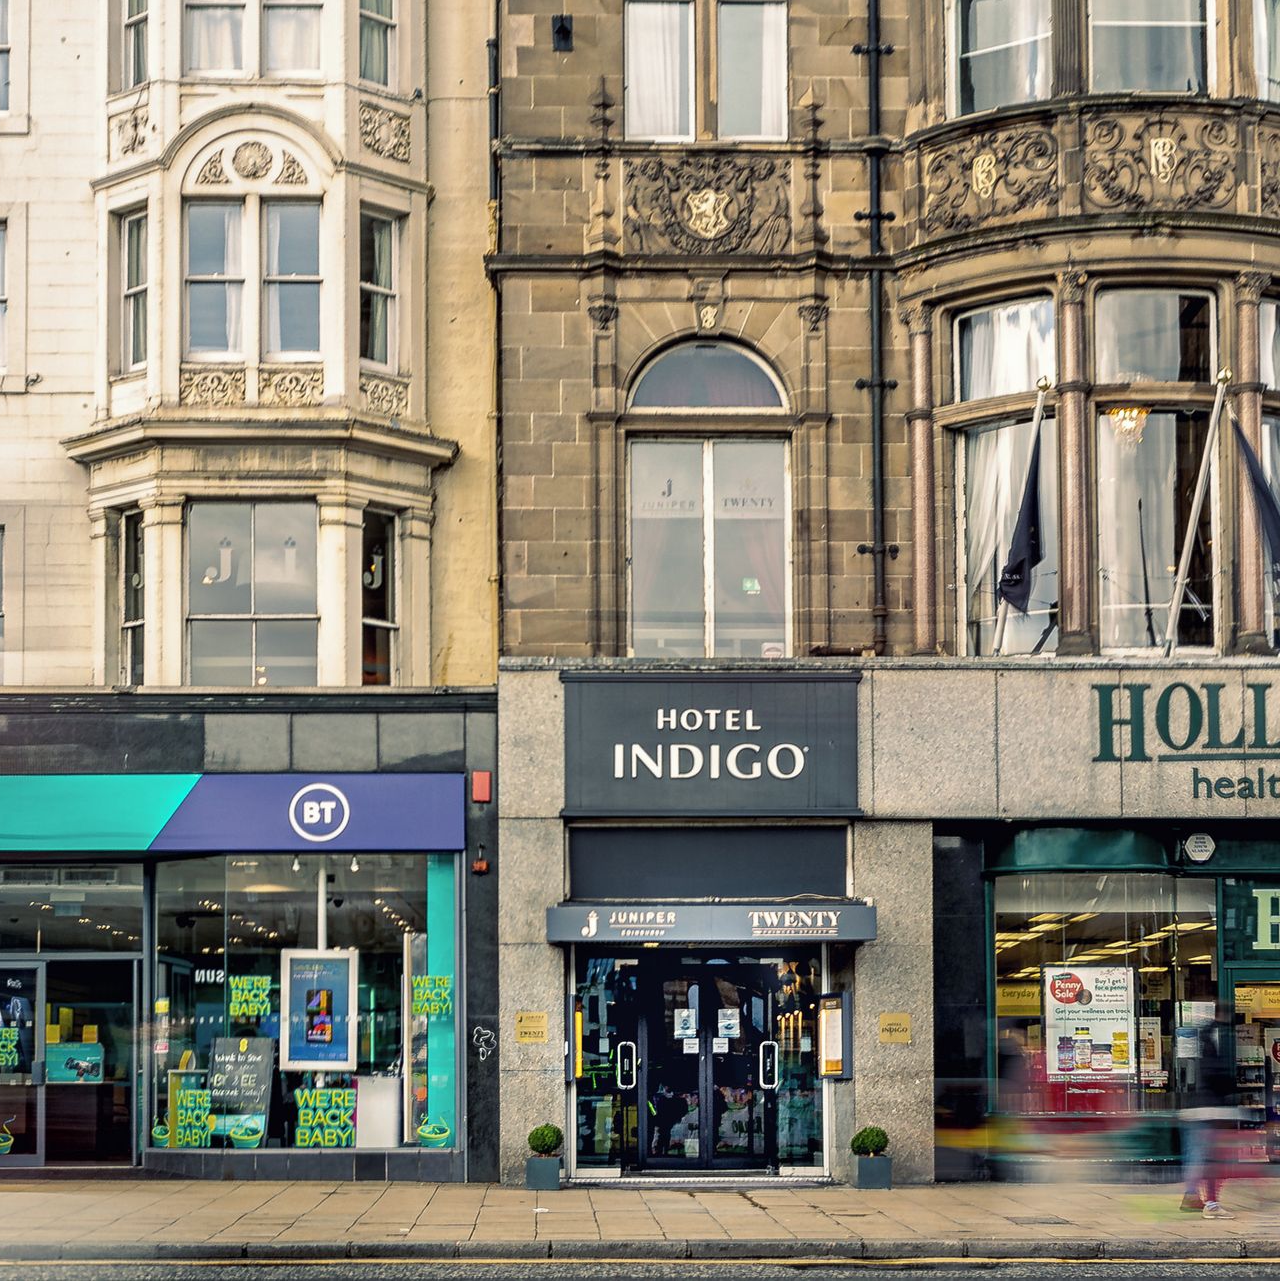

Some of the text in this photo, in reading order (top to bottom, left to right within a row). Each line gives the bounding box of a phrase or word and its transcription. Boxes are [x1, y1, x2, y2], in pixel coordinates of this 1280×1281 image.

[722, 497, 776, 508] TWENTY
[656, 708, 762, 732] HOTEL
[613, 742, 807, 780] INDIGO
[302, 800, 338, 825] BT
[608, 911, 676, 924] JUNIPER
[748, 910, 841, 928] TWENTY
[1055, 979, 1082, 992] Penny
[1094, 977, 1106, 985] Buy
[231, 989, 270, 1002] BACK
[414, 989, 450, 1001] BACK
[1001, 988, 1036, 999] Everyday
[1055, 989, 1074, 998] Sale
[1055, 1007, 1067, 1015] Get
[1068, 1008, 1081, 1016] your
[177, 1109, 211, 1127] BACK
[298, 1108, 355, 1128] BACK
[295, 1127, 356, 1148] BABY!
